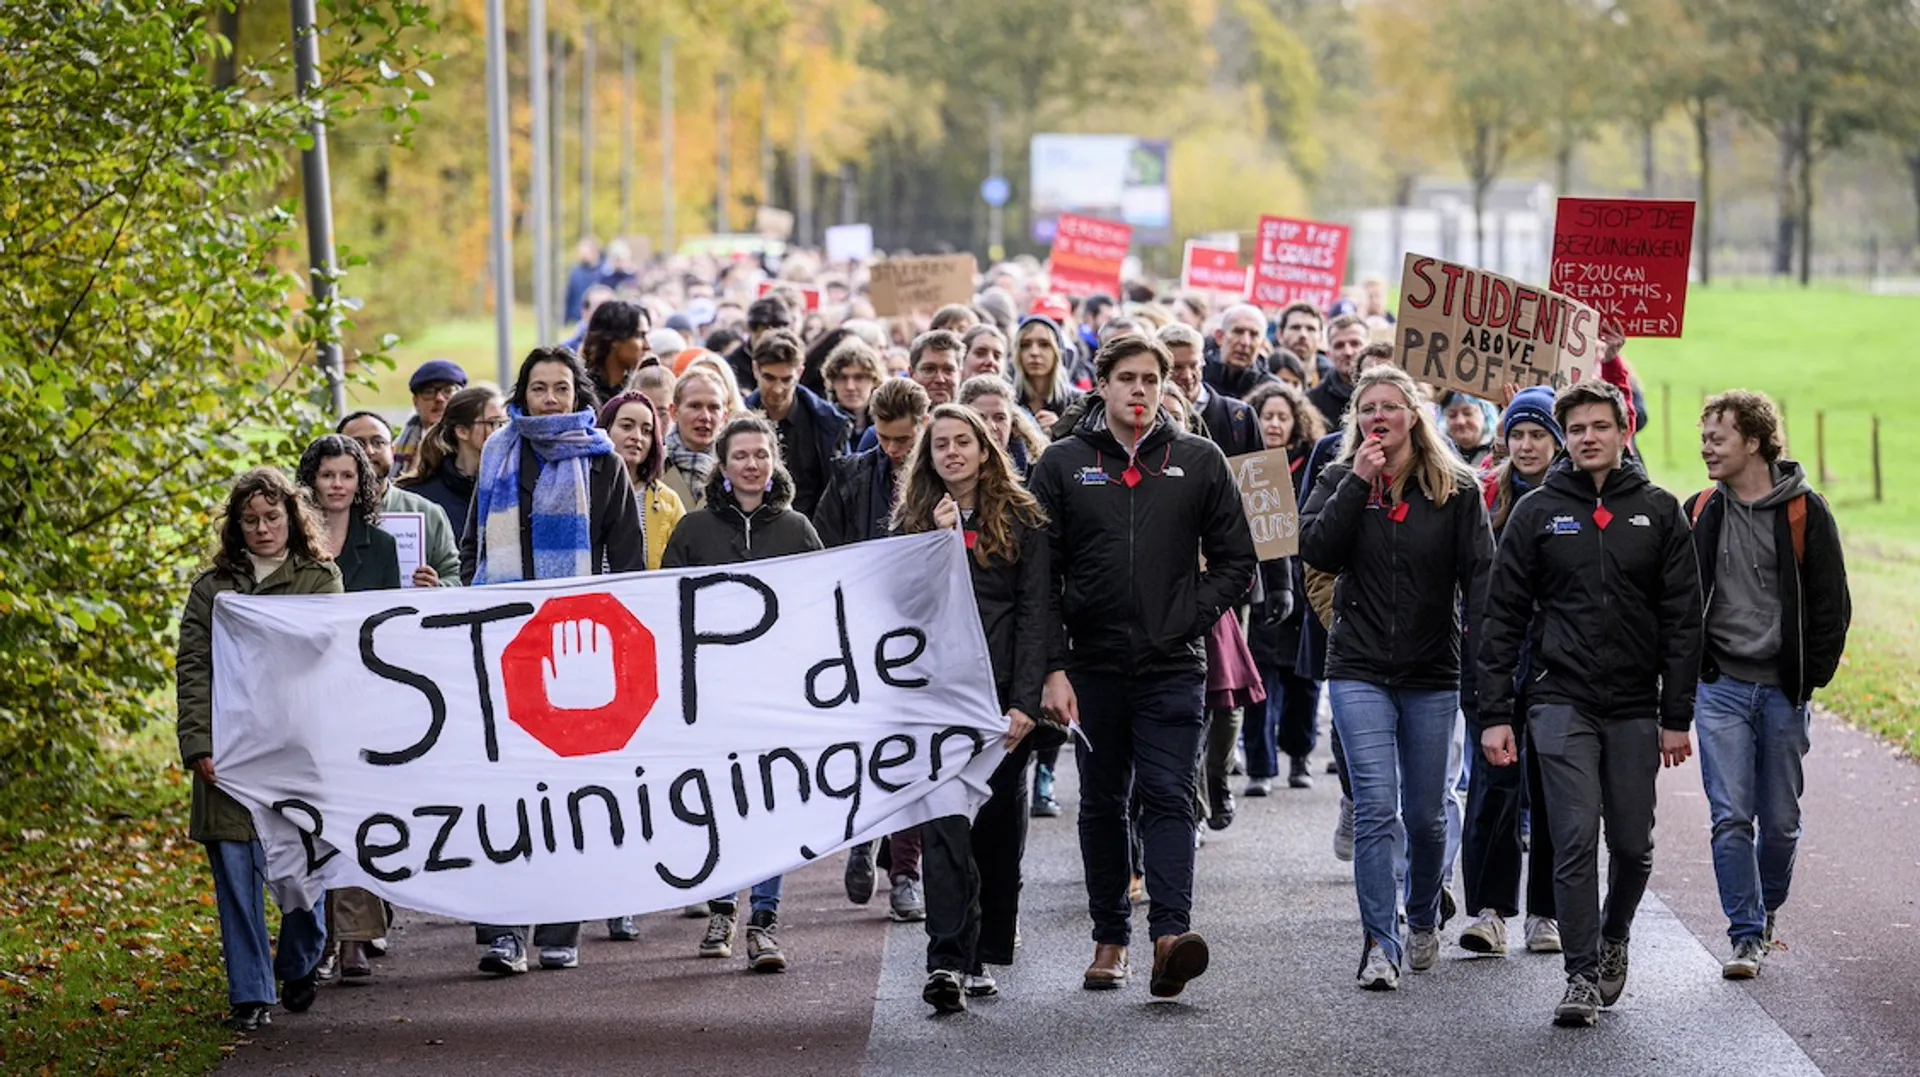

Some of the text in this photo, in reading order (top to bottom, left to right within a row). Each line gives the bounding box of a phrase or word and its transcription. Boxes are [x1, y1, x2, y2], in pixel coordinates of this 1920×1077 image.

[1575, 203, 1686, 231] STOP DE
[1552, 258, 1576, 287] (IF
[1408, 257, 1591, 357] STUDENTS
[1561, 281, 1672, 304] READ THIS,
[1462, 327, 1534, 366] ABOVE
[1250, 513, 1296, 543] CUTS
[359, 572, 929, 766] STOP de
